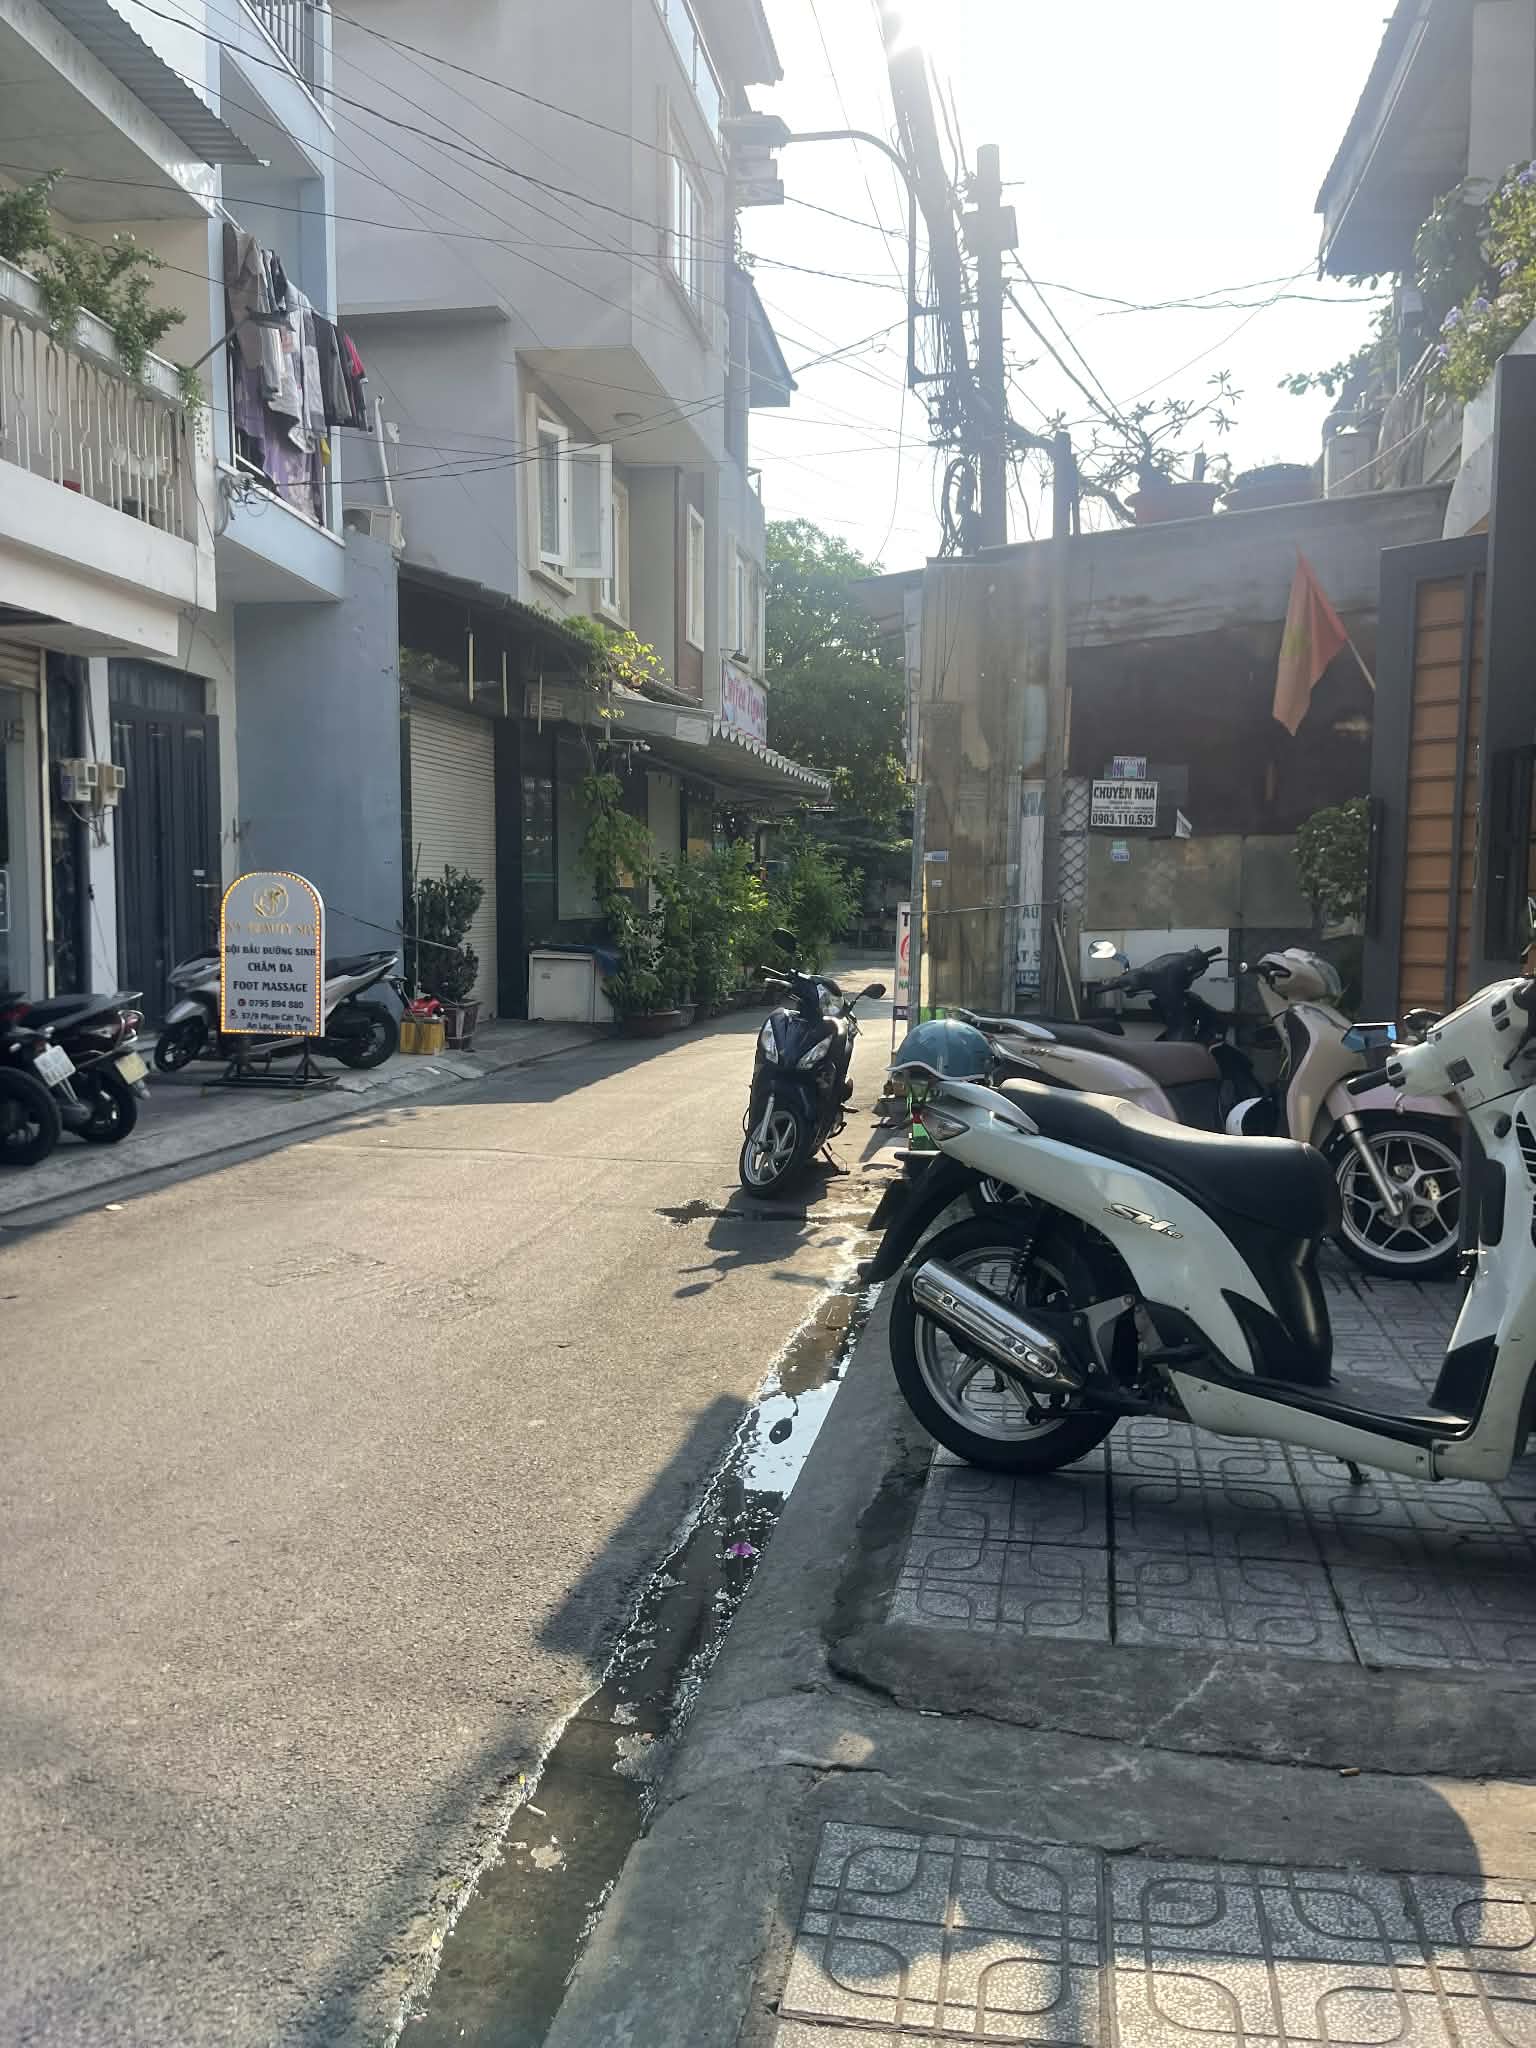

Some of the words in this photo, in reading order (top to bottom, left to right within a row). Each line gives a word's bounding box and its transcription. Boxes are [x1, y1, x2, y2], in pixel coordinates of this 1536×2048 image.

[1092, 813, 1154, 825] 0903.110.533
[280, 963, 294, 973] DA
[233, 980, 258, 991] FOOT
[262, 982, 309, 993] MASSAGE
[249, 999, 269, 1008] 0795
